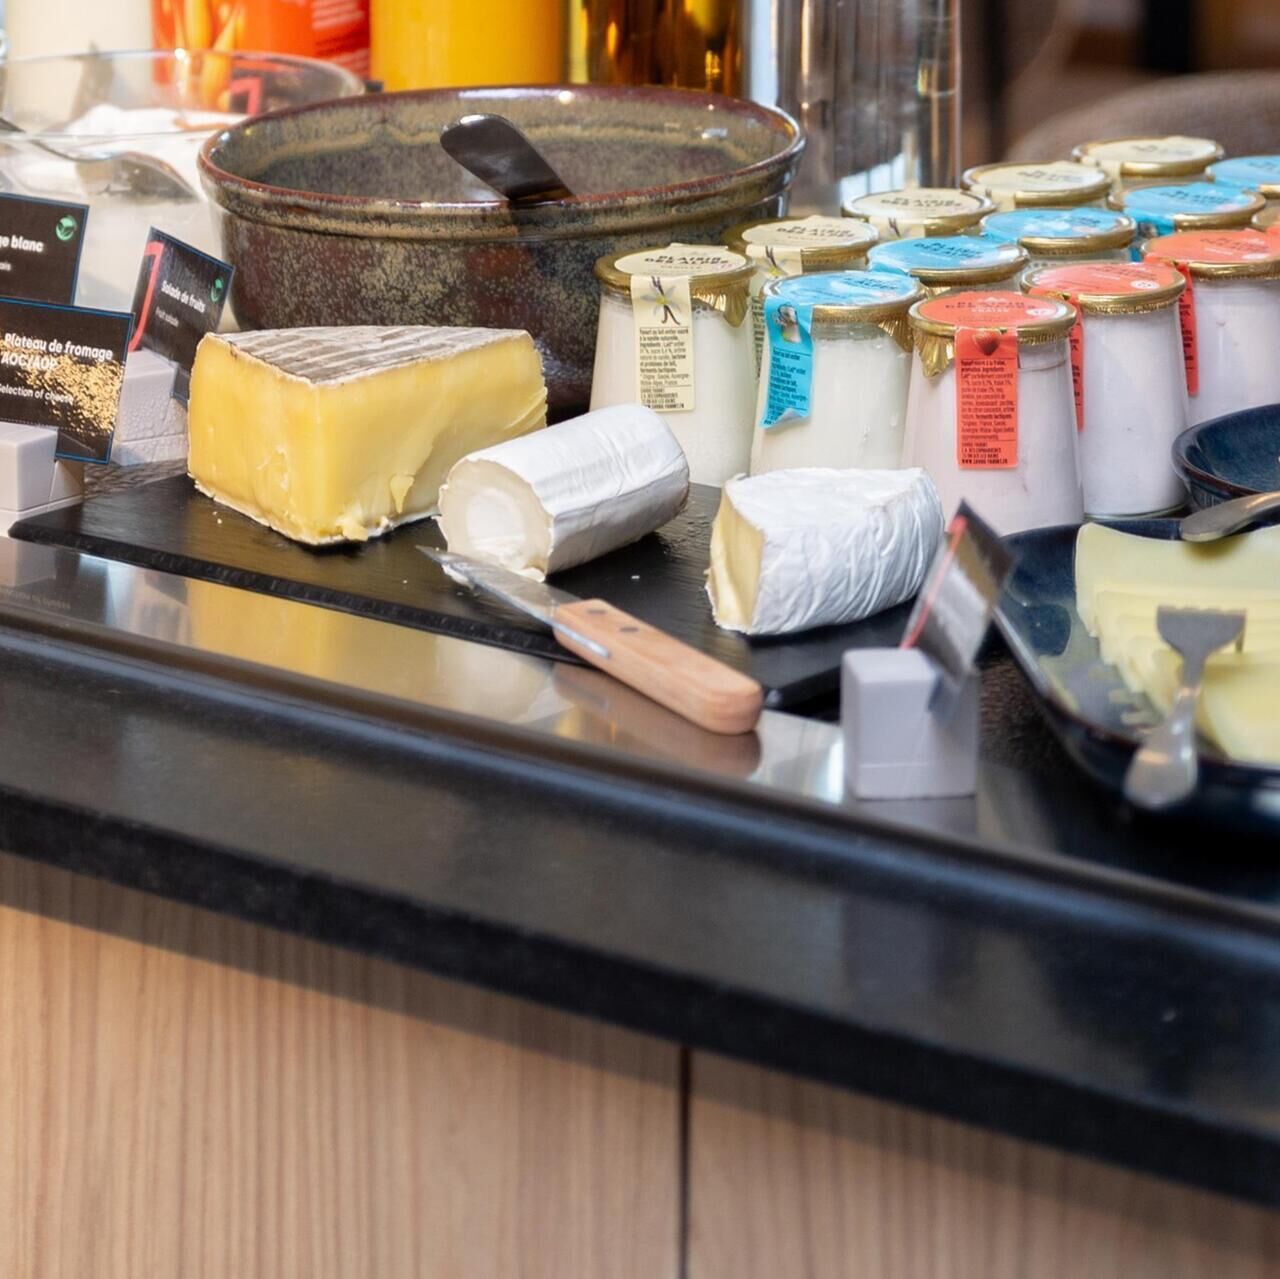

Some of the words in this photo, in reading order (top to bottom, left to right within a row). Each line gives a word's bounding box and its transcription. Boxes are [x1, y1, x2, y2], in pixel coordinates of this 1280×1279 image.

[11, 234, 44, 253] blanc
[161, 280, 181, 300] Salade
[180, 291, 189, 304] de
[189, 294, 206, 314] fruits
[4, 333, 47, 352] Plateau
[48, 339, 62, 353] de
[64, 341, 113, 361] fromage
[1, 351, 58, 370] AOC/AOP
[35, 390, 44, 399] of
